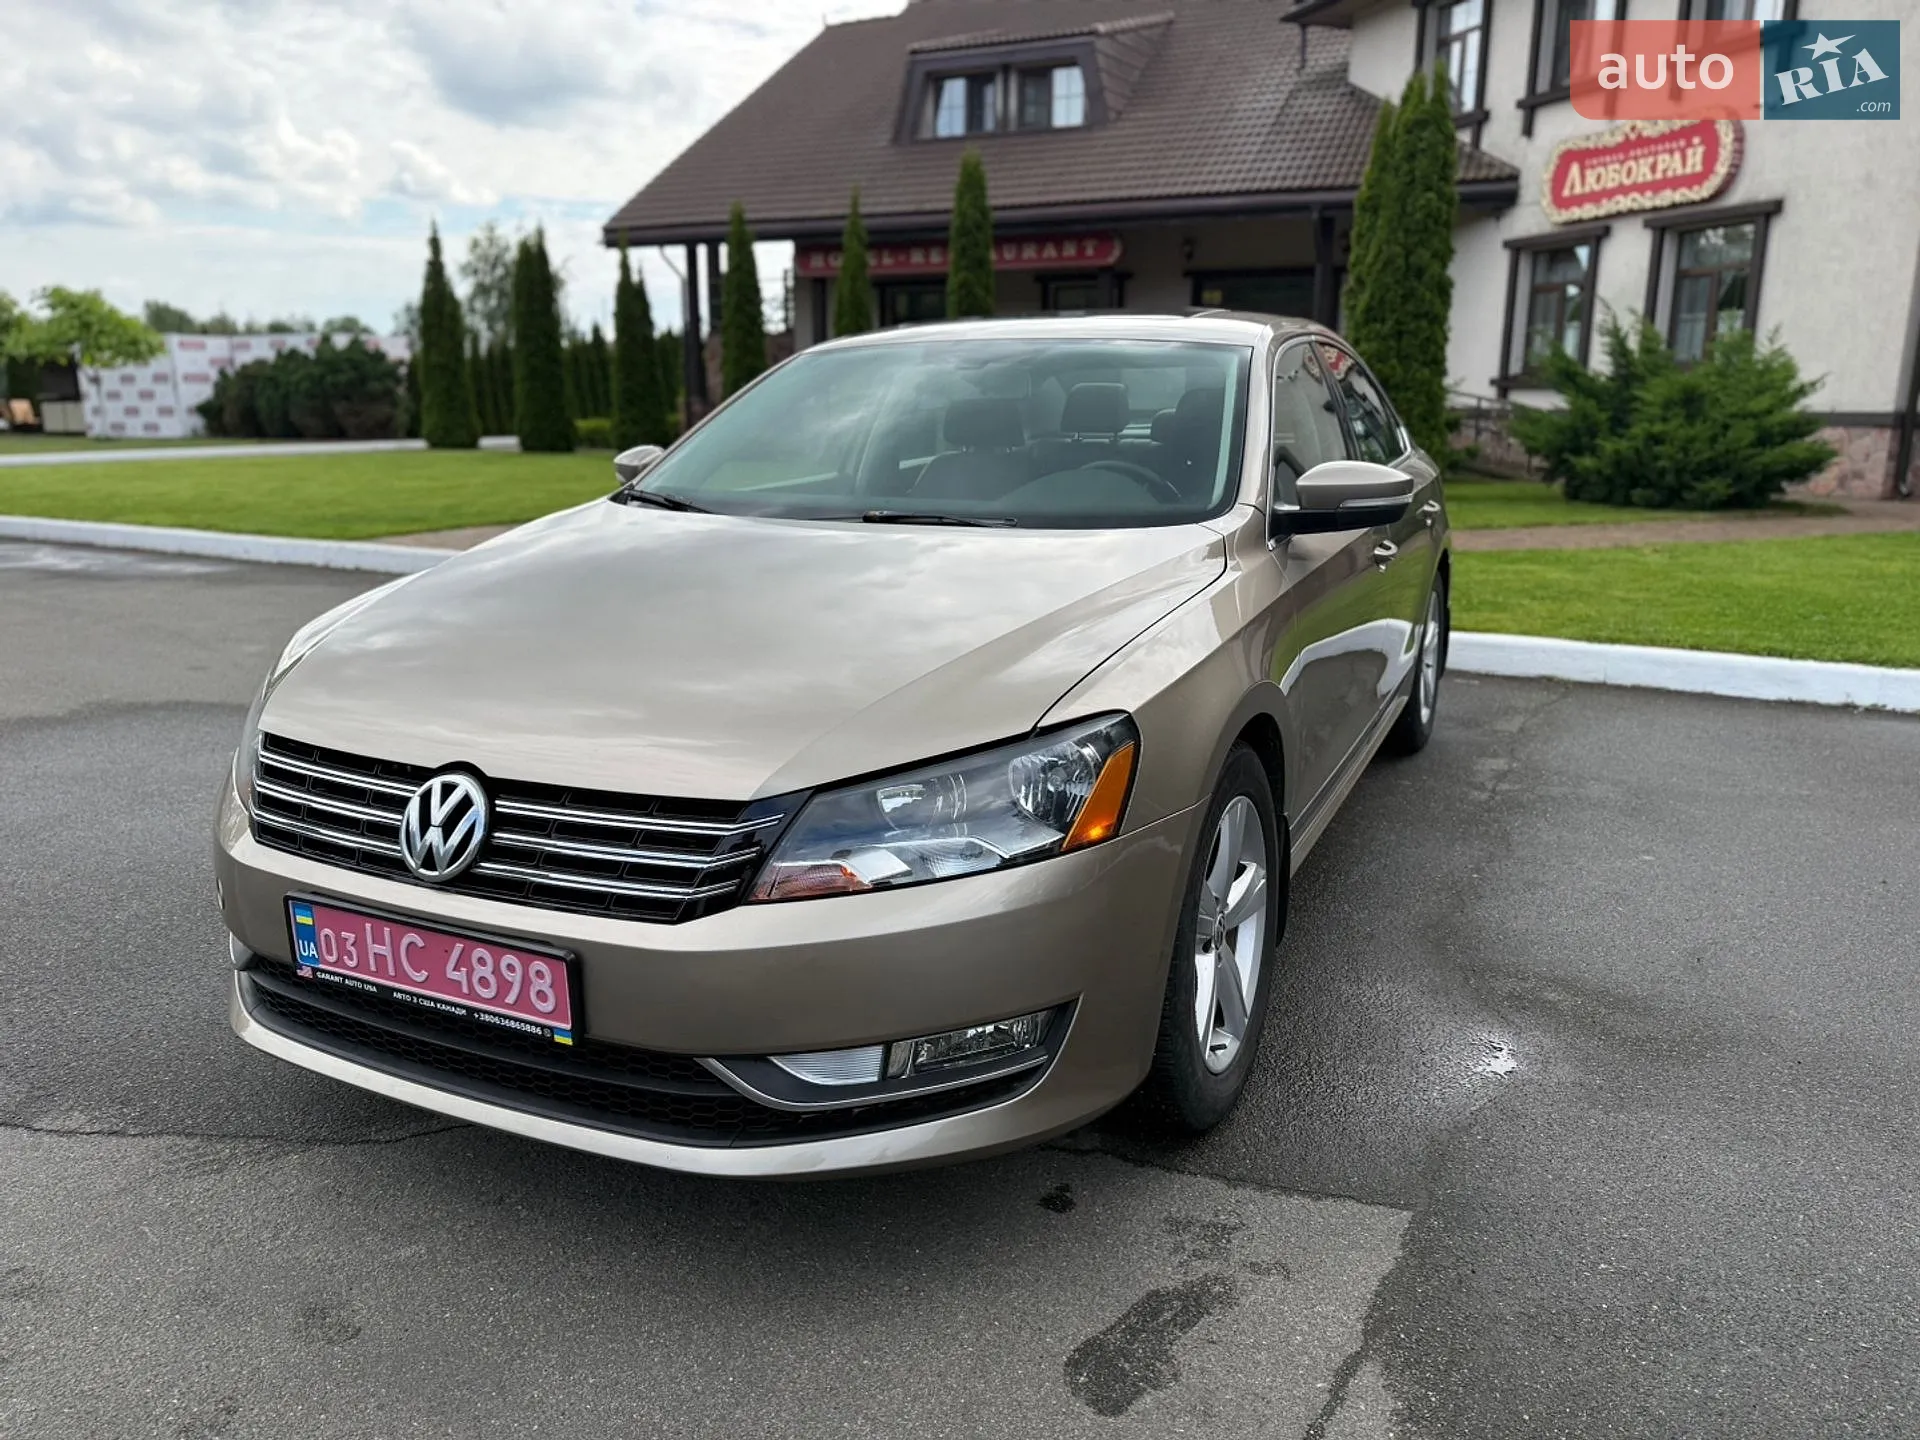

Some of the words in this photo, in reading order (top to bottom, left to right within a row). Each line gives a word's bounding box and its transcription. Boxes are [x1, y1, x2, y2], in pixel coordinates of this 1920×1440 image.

[1561, 136, 1706, 197] ЛЮБОКРАЙ
[299, 939, 319, 960] UA
[316, 971, 343, 984] GARANT
[345, 978, 363, 989] AUTO
[363, 984, 378, 993] USA
[445, 943, 557, 1014] 4898
